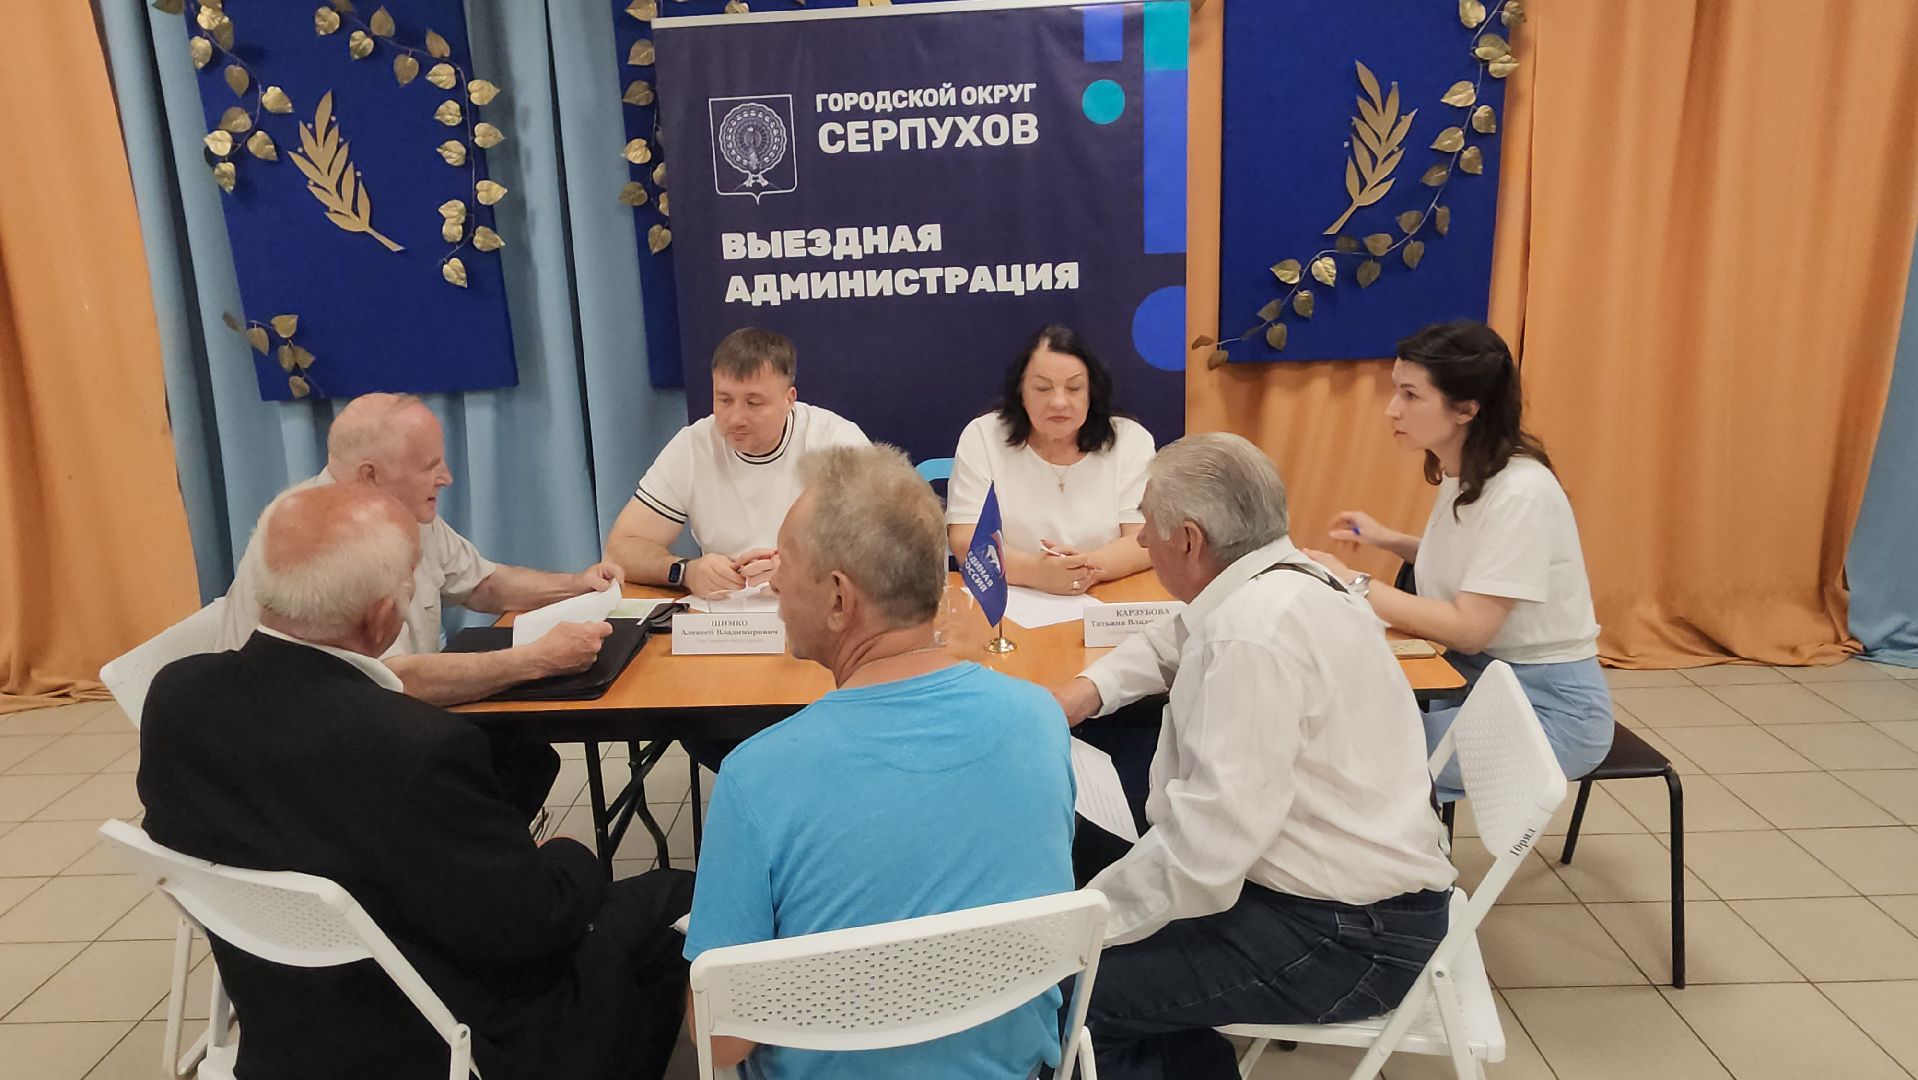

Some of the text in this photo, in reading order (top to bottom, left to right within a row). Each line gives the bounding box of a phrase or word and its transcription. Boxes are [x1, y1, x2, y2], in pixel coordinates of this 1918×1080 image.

[816, 83, 1036, 112] ГОРОДСКОЙ ОКРУГ
[819, 113, 1038, 153] СЕРПУХОВ
[722, 224, 941, 260] ВЫЕЗДНАЯ
[725, 262, 1078, 306] АДМИНИСТРАЦИЯ
[965, 557, 988, 593] ОССИЯ
[967, 550, 994, 588] ЕДИНАЯ
[1116, 608, 1170, 617] КАРЗУБОВА
